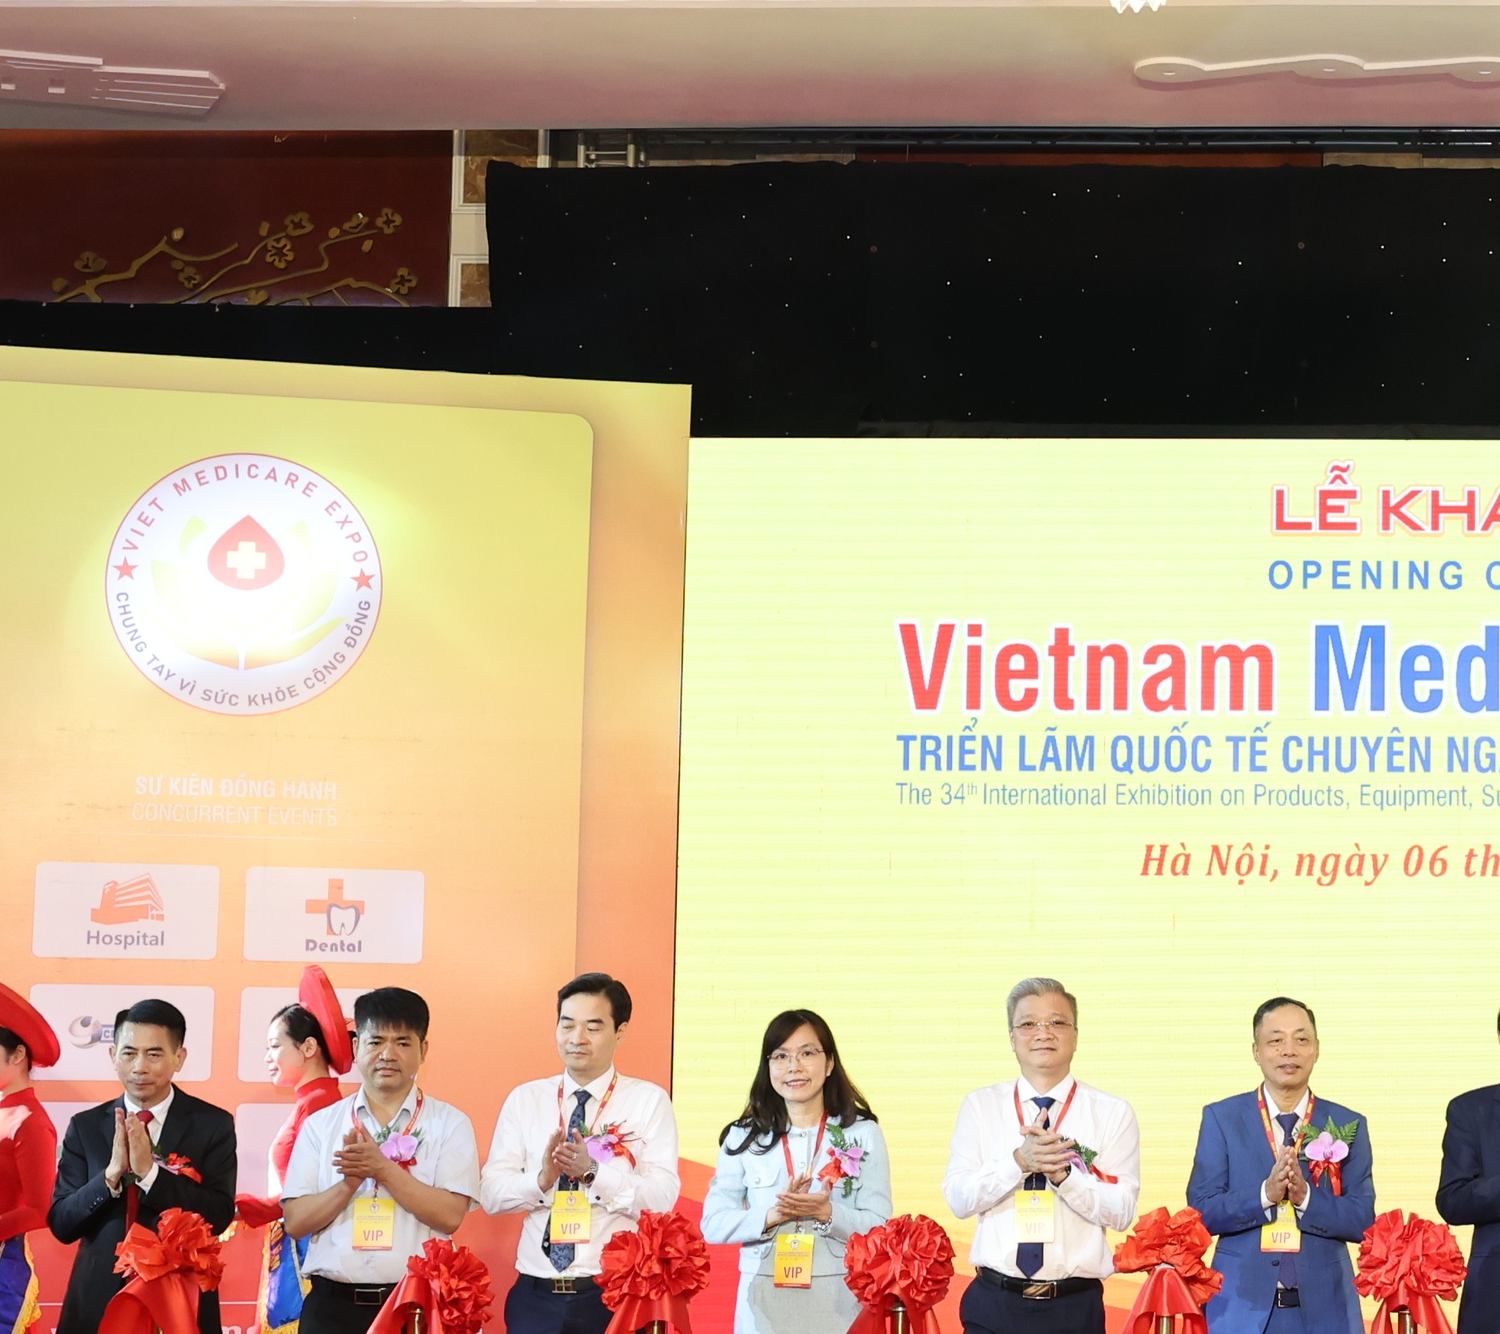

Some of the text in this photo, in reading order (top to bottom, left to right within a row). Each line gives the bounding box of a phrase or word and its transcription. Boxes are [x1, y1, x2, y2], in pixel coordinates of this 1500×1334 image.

[1274, 462, 1360, 533] LỄ
[121, 463, 369, 563] VIET MEDICARE EXPO
[1268, 559, 1465, 591] OPENING
[115, 591, 371, 708] CHUNG TAY VÌ SỨC KHỎE CỘNG ĐỒNG
[898, 621, 1275, 714] Vietnam
[896, 716, 1003, 773] TRIỂN
[1018, 726, 1096, 773] LÃM
[1109, 720, 1213, 775] QUỐC
[1225, 721, 1269, 773] TẾ
[1281, 727, 1433, 774] CHUYÊN
[134, 773, 164, 800] SỰ
[168, 772, 214, 800] KIỆN
[896, 782, 932, 806] The
[940, 781, 979, 806] 34th
[983, 782, 1107, 807] International
[1115, 783, 1213, 807] Exhibition
[1220, 788, 1246, 807] on
[1253, 783, 1351, 810] Products,
[1359, 784, 1474, 812] Equipment,
[131, 801, 338, 827] CONCURRENT EVENTS
[1140, 842, 1192, 877] Hà
[1205, 842, 1280, 886] Nội,
[1294, 842, 1390, 887] ngày
[1402, 844, 1450, 878] 06
[86, 929, 166, 950] Hospital
[304, 938, 363, 954] Dental
[363, 1229, 384, 1242] VIP
[560, 1222, 581, 1235] VIP
[1271, 1231, 1291, 1244] VIP
[783, 1266, 803, 1279] VIP
